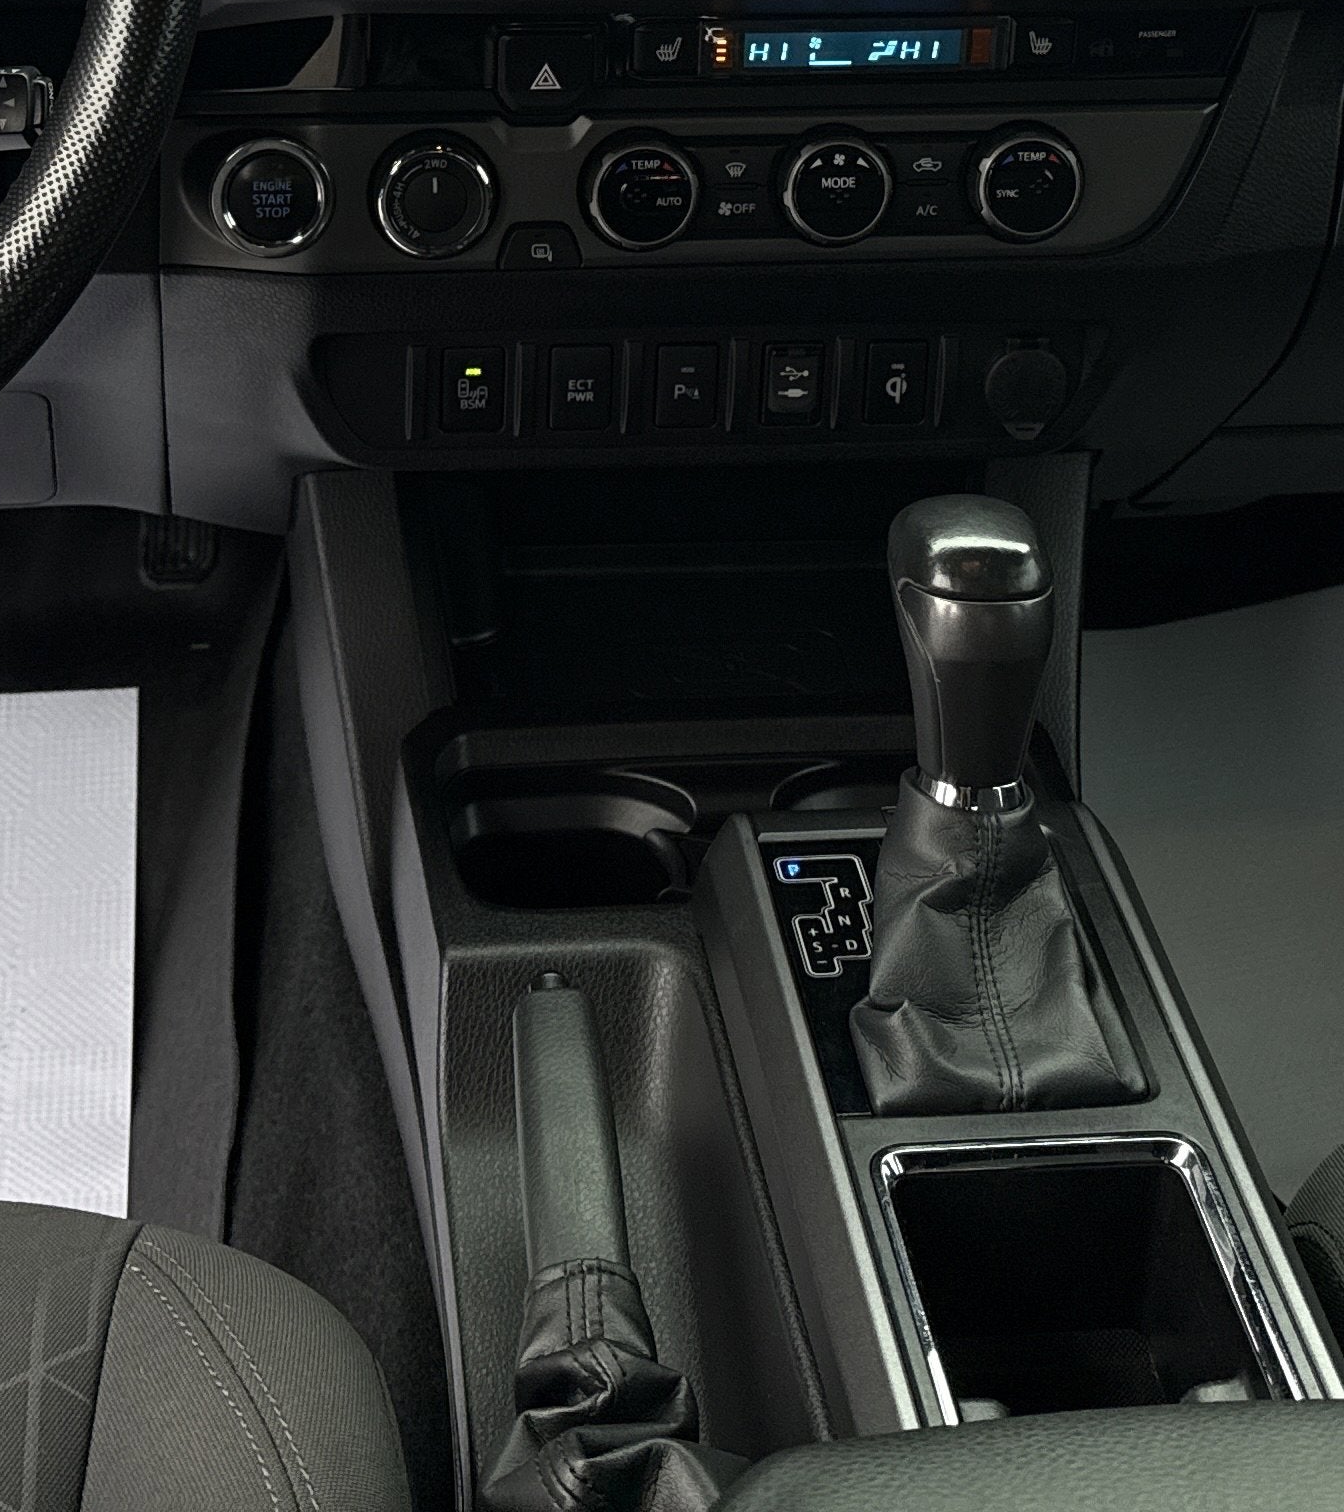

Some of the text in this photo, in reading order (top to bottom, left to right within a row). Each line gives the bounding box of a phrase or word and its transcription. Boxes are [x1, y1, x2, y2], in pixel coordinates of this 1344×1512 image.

[1138, 30, 1176, 39] PASSENGER
[1017, 151, 1047, 162] TEMP
[423, 158, 448, 170] 2WD
[631, 159, 661, 170] TEMP
[252, 180, 292, 191] ENGINE
[821, 177, 856, 189] MODE
[252, 194, 292, 205] START
[996, 189, 1020, 199] SYNC
[656, 196, 682, 207] AUTO
[256, 207, 291, 218] STOP
[732, 203, 756, 214] OFF
[916, 205, 938, 217] A/C
[568, 379, 595, 390] ECT
[567, 391, 595, 402] PWR
[460, 399, 486, 410] BSM
[787, 864, 800, 877] P
[839, 887, 851, 898] R
[838, 914, 851, 927] N
[812, 941, 823, 952] S
[845, 939, 858, 951] D
